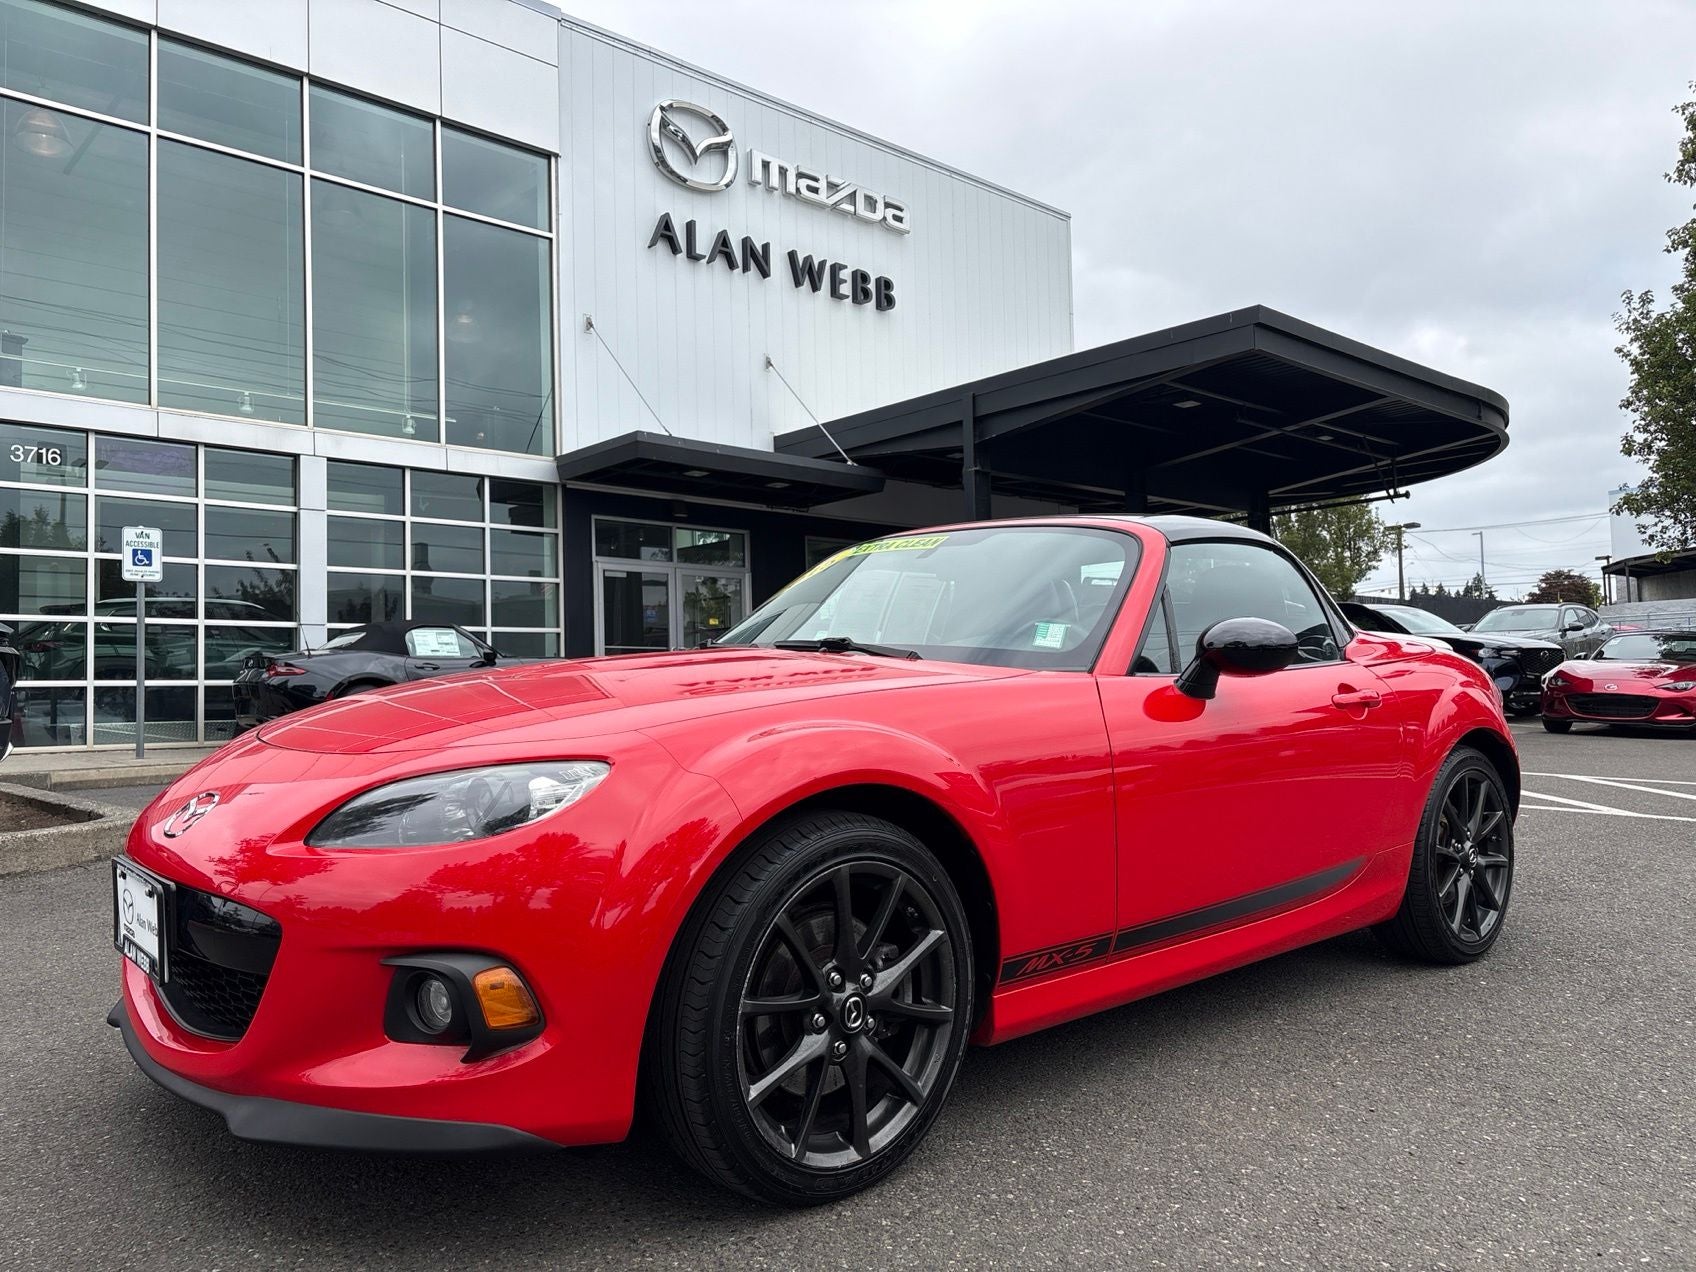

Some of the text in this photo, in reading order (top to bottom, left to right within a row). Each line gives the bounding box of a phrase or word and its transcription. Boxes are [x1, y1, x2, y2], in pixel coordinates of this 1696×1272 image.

[748, 148, 911, 235] mazda
[647, 212, 896, 312] ALAN WEBB
[10, 444, 62, 466] 3716
[125, 540, 160, 549] ACCESSIBLE
[135, 532, 150, 540] VAN
[1015, 942, 1098, 977] MX-5
